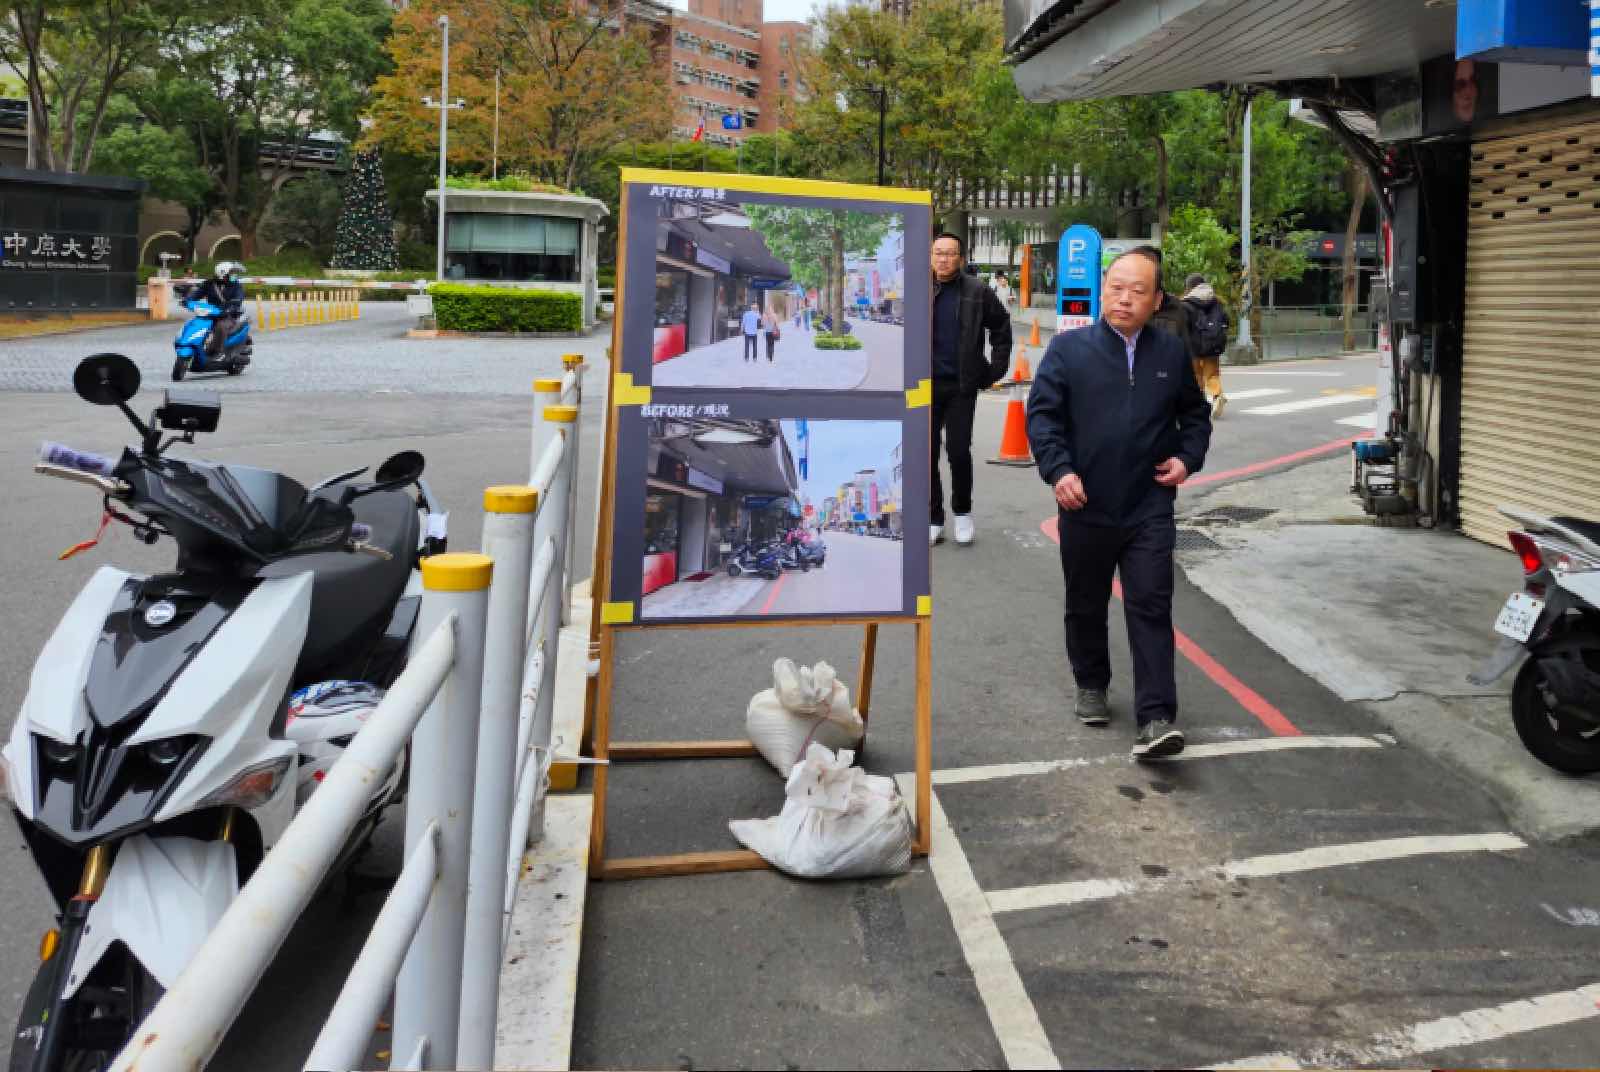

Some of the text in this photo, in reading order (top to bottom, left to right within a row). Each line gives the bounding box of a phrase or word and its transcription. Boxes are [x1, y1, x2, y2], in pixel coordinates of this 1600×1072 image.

[648, 184, 697, 200] AFTER
[3, 232, 111, 261] 中原大學
[1068, 239, 1087, 262] P
[640, 403, 695, 418] BEFORE
